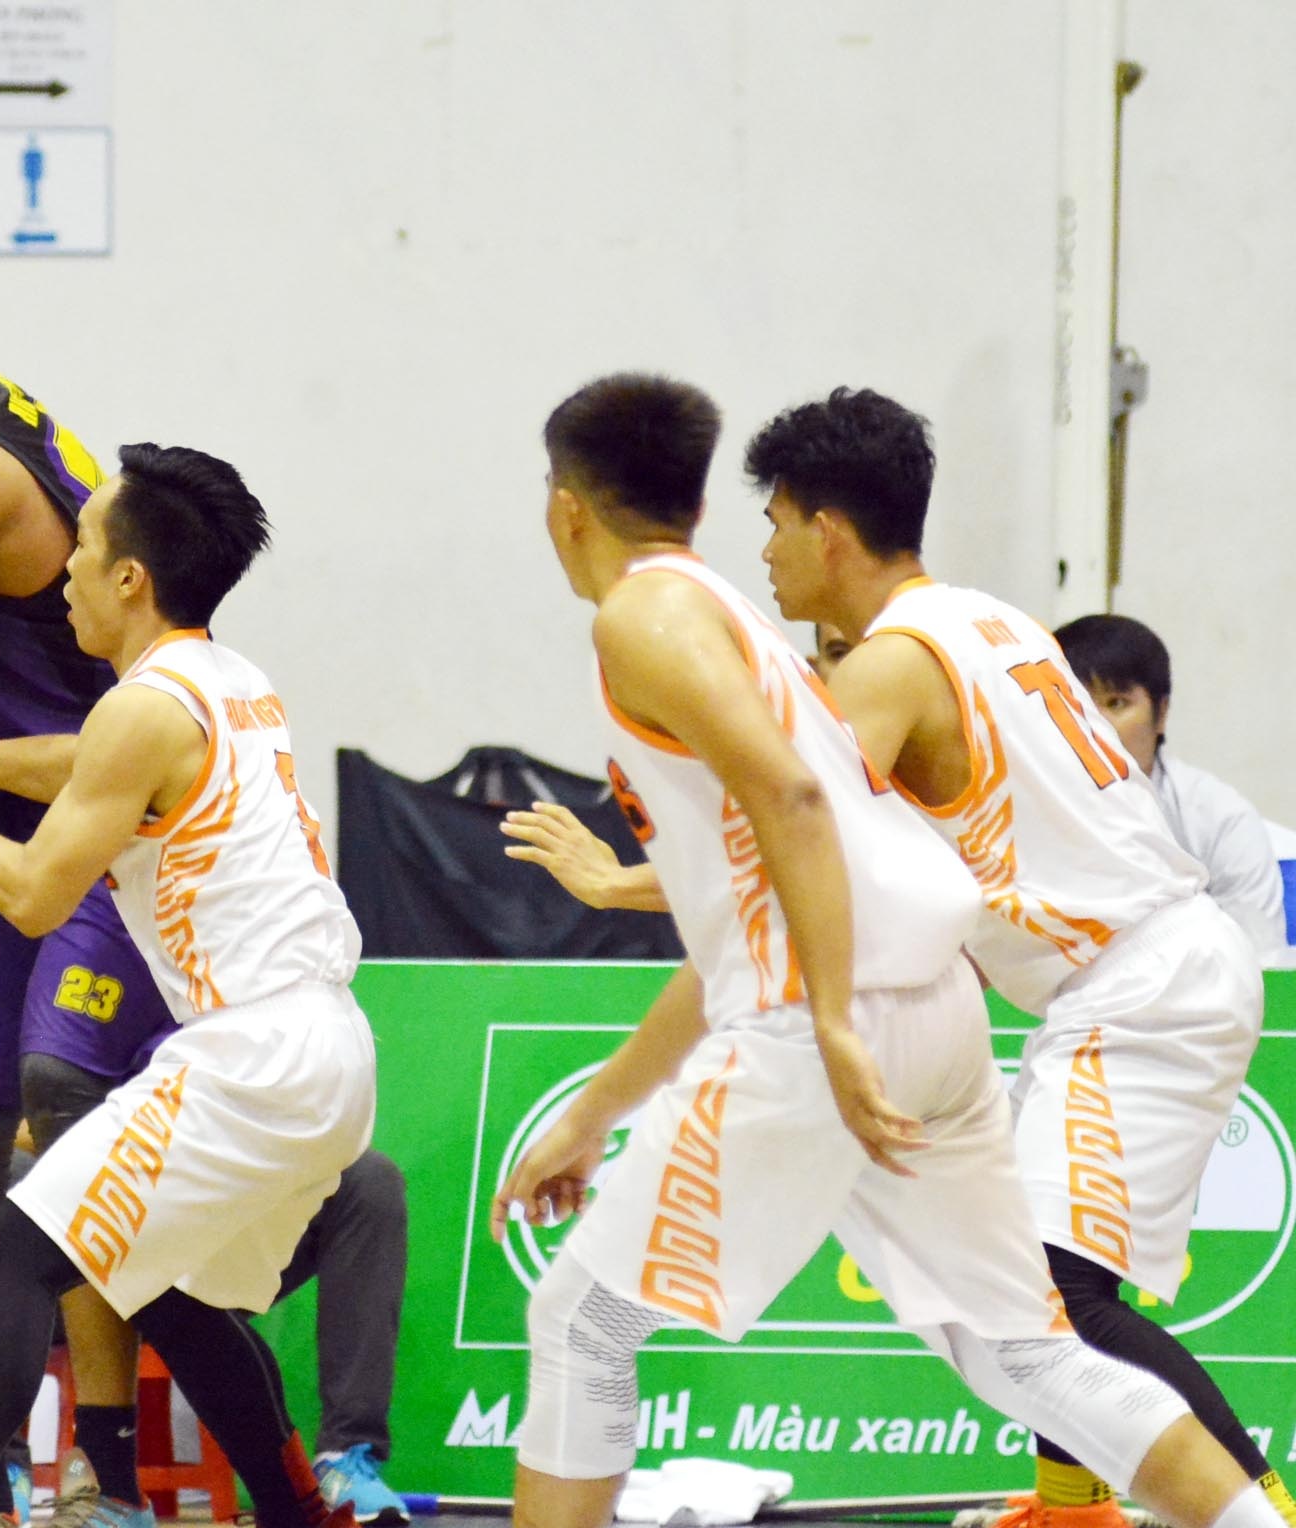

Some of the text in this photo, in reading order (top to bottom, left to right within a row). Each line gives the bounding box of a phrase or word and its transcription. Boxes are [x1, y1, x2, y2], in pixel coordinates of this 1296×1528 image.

[53, 964, 125, 1024] 23
[729, 1404, 840, 1451] Màu
[849, 1409, 981, 1455] xanh
